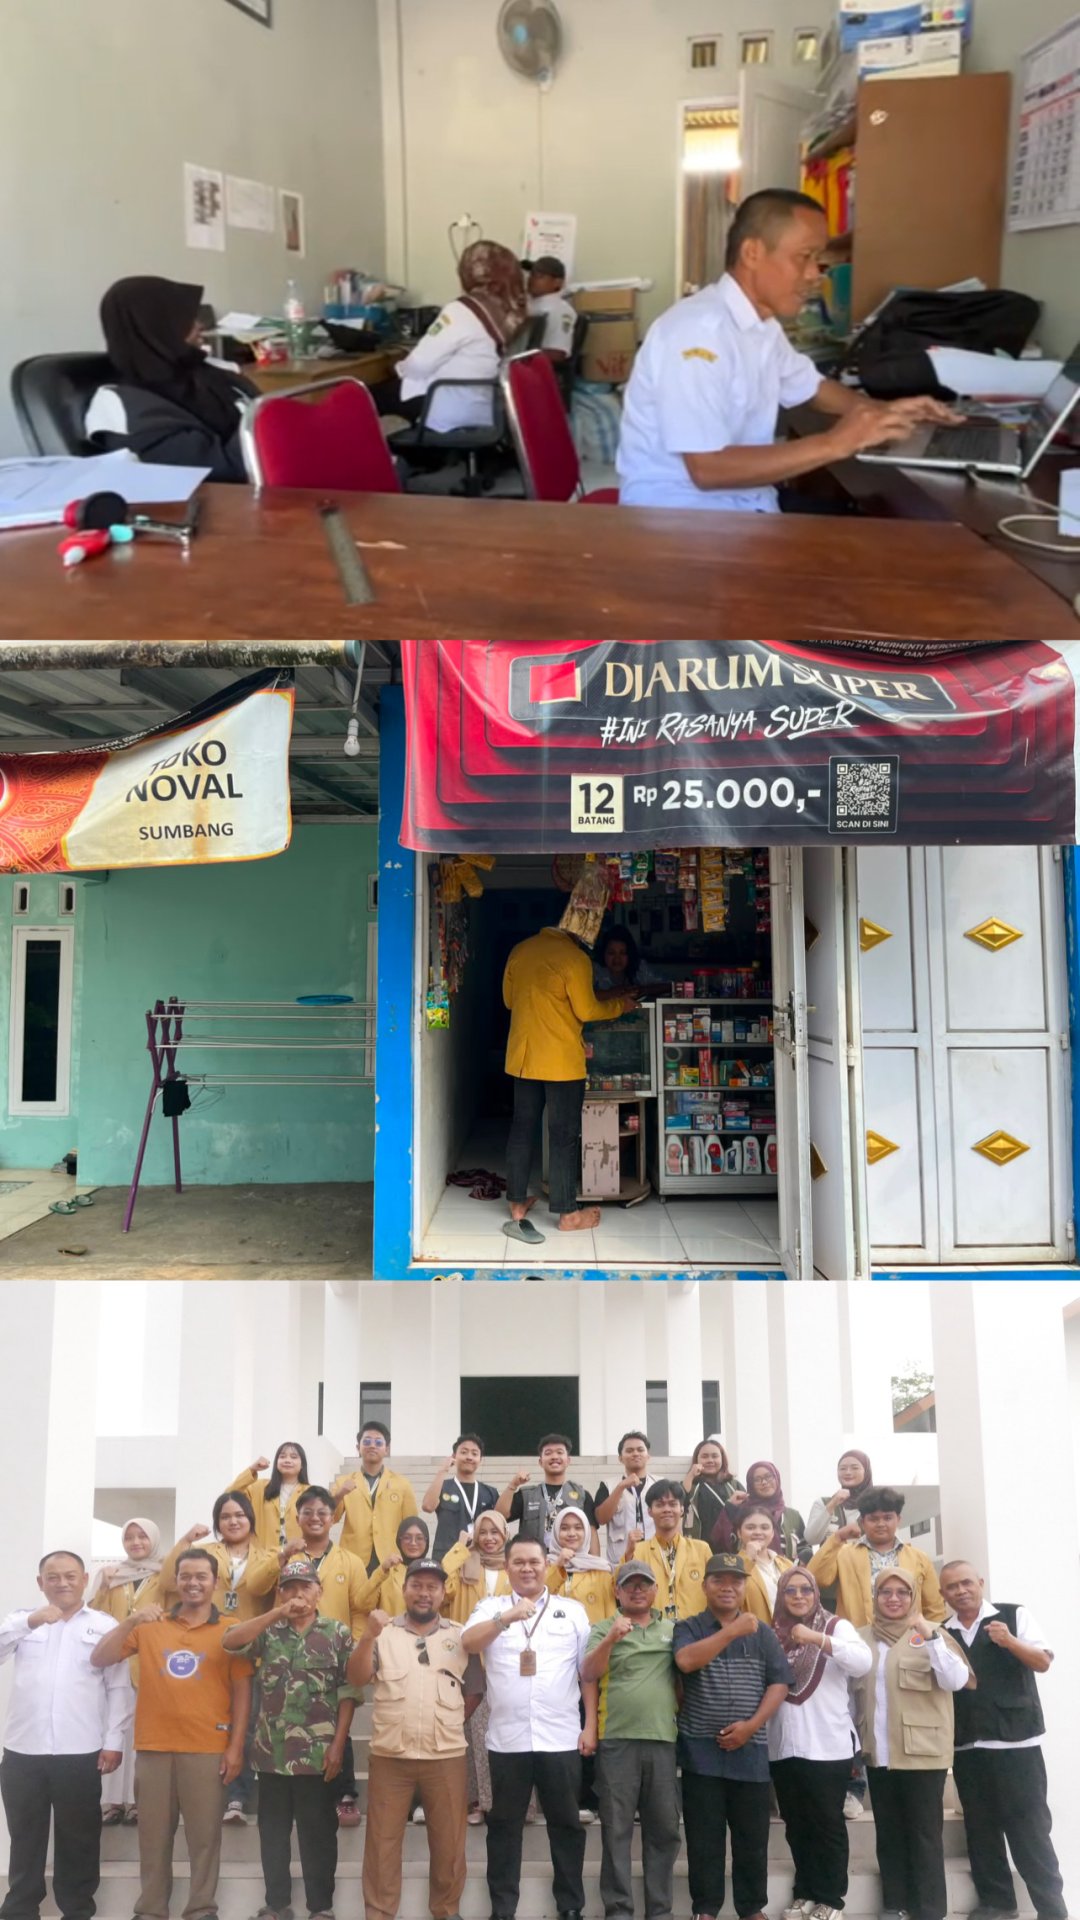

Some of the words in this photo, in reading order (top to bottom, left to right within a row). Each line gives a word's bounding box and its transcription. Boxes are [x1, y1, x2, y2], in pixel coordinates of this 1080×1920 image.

[877, 641, 924, 650] BERHENTI
[904, 650, 924, 658] DAN
[604, 654, 783, 701] DJARUM
[792, 661, 933, 701] SUPER
[656, 709, 757, 745] RASANYA
[764, 702, 859, 741] SUPER
[149, 740, 227, 776] TOKO
[125, 773, 243, 803] NOVAL
[578, 782, 615, 814] 12
[634, 786, 657, 808] Rp
[663, 777, 821, 813] 25.000,-
[139, 823, 234, 840] SUMBANG
[578, 815, 615, 826] BATANG
[836, 820, 861, 828] SCAN
[862, 820, 871, 828] DI
[872, 820, 889, 828] SINI
